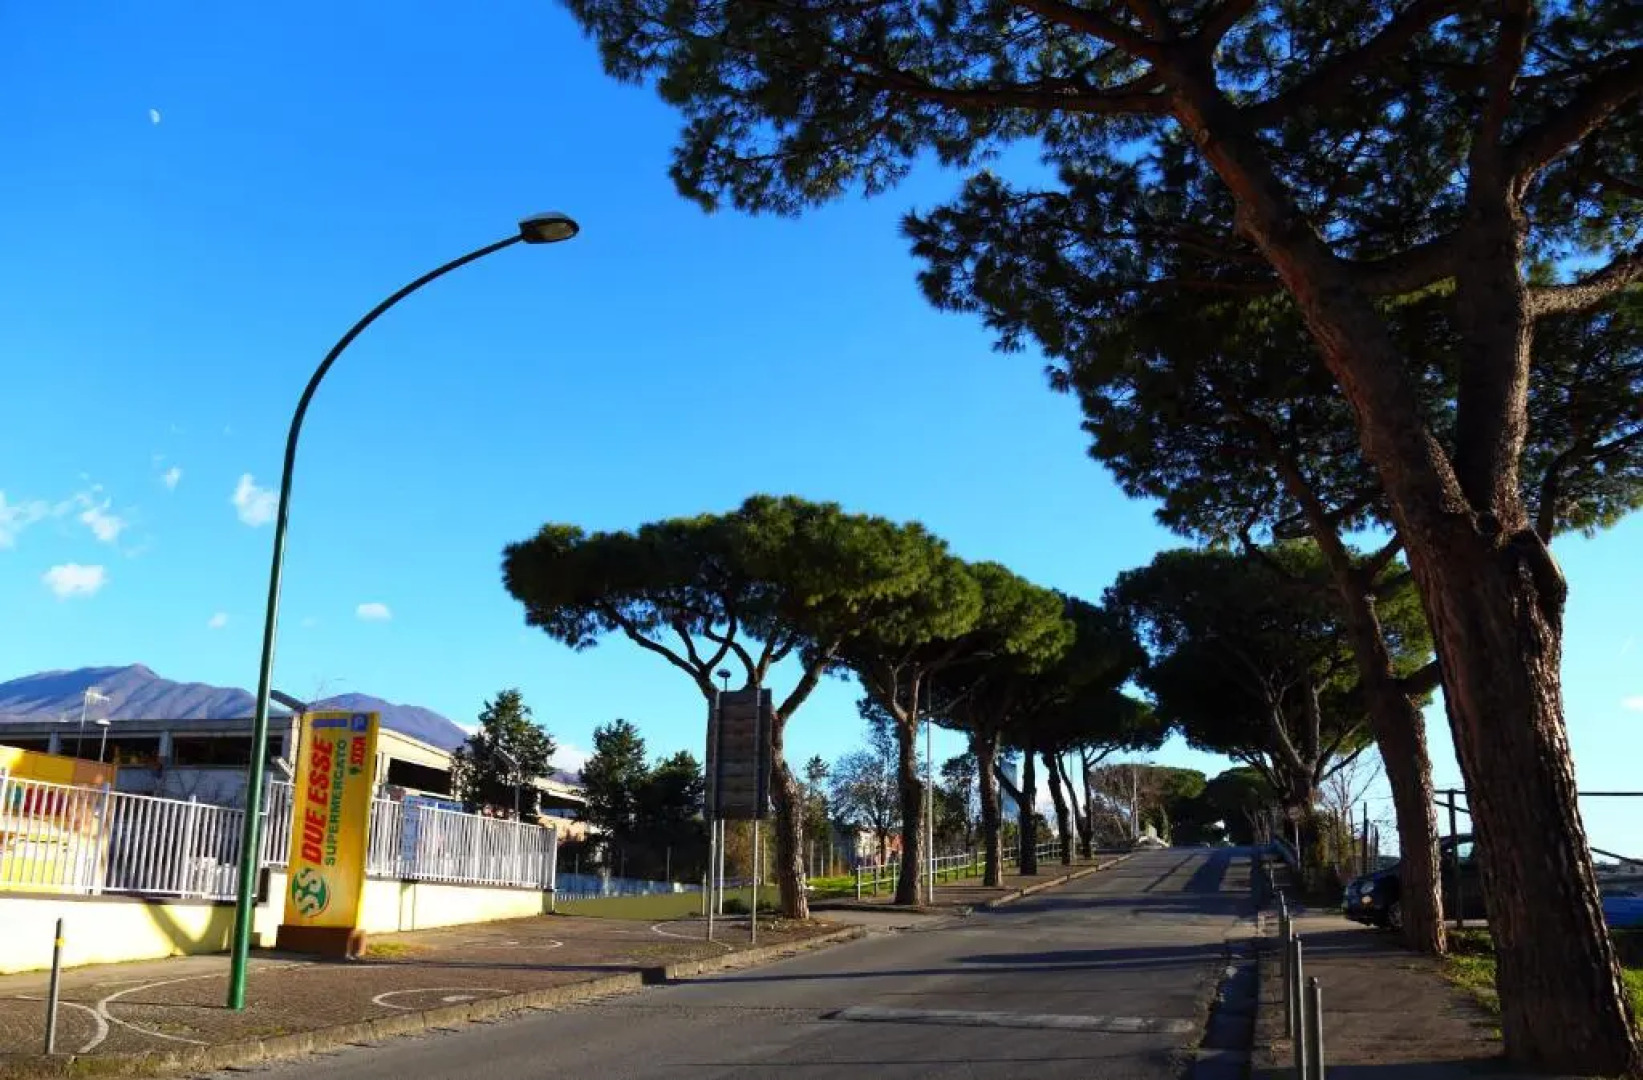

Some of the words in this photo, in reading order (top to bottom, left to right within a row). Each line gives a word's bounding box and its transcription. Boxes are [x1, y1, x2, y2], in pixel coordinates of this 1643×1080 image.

[308, 735, 333, 806] ESSE
[326, 739, 347, 867] SUPERMERCATO
[301, 808, 326, 866] DUE
